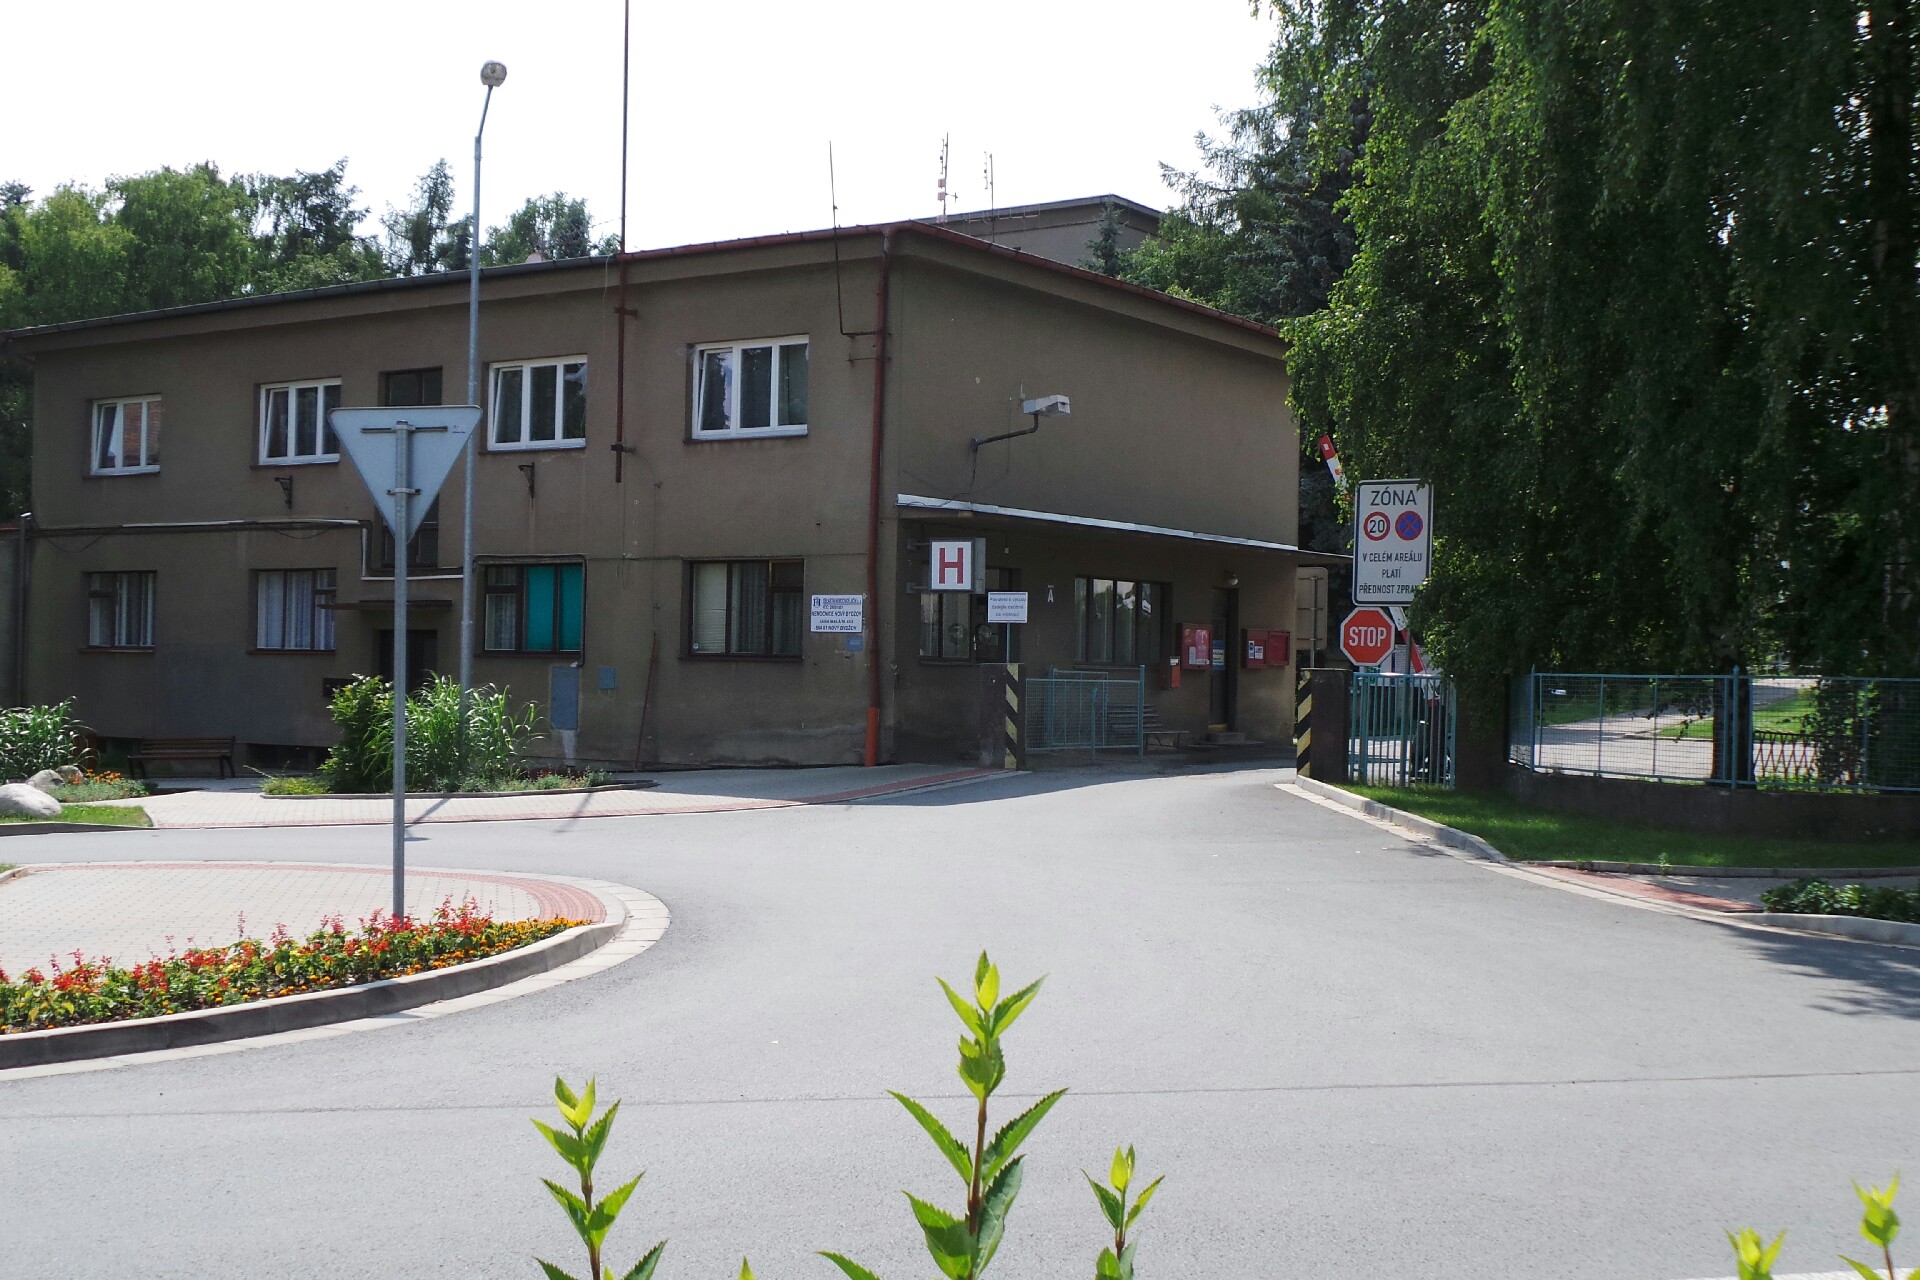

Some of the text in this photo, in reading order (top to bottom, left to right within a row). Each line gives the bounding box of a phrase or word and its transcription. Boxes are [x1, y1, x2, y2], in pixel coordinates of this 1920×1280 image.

[1370, 486, 1417, 506] ZÓNA
[1369, 519, 1385, 534] 20
[1363, 550, 1422, 563] V CELÉM AREÁLU
[939, 547, 964, 585] H
[1381, 567, 1402, 579] PLATÍ
[1359, 583, 1395, 594] PŘEDNOST
[1348, 626, 1387, 647] STOP
